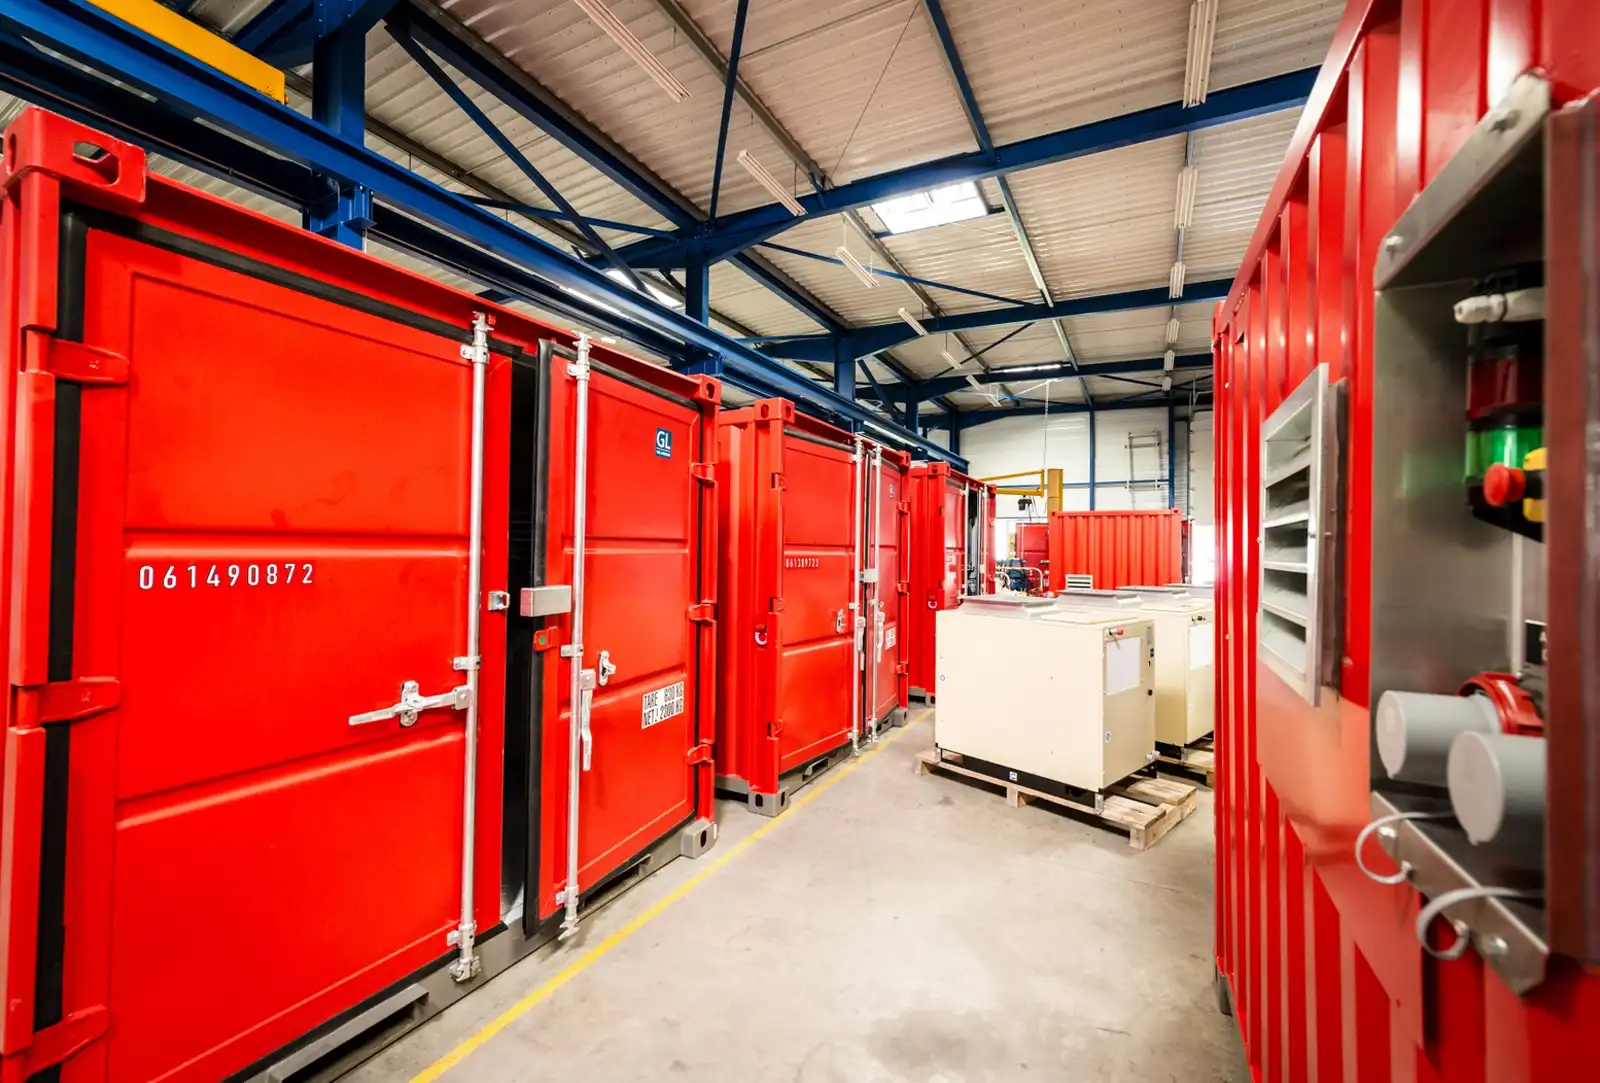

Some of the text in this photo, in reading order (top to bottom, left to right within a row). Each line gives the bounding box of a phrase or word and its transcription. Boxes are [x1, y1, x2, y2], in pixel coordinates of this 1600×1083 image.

[657, 431, 671, 450] GL
[138, 563, 313, 590] 061490872
[644, 691, 658, 710] TARE
[676, 682, 684, 698] KG
[675, 697, 684, 713] KG
